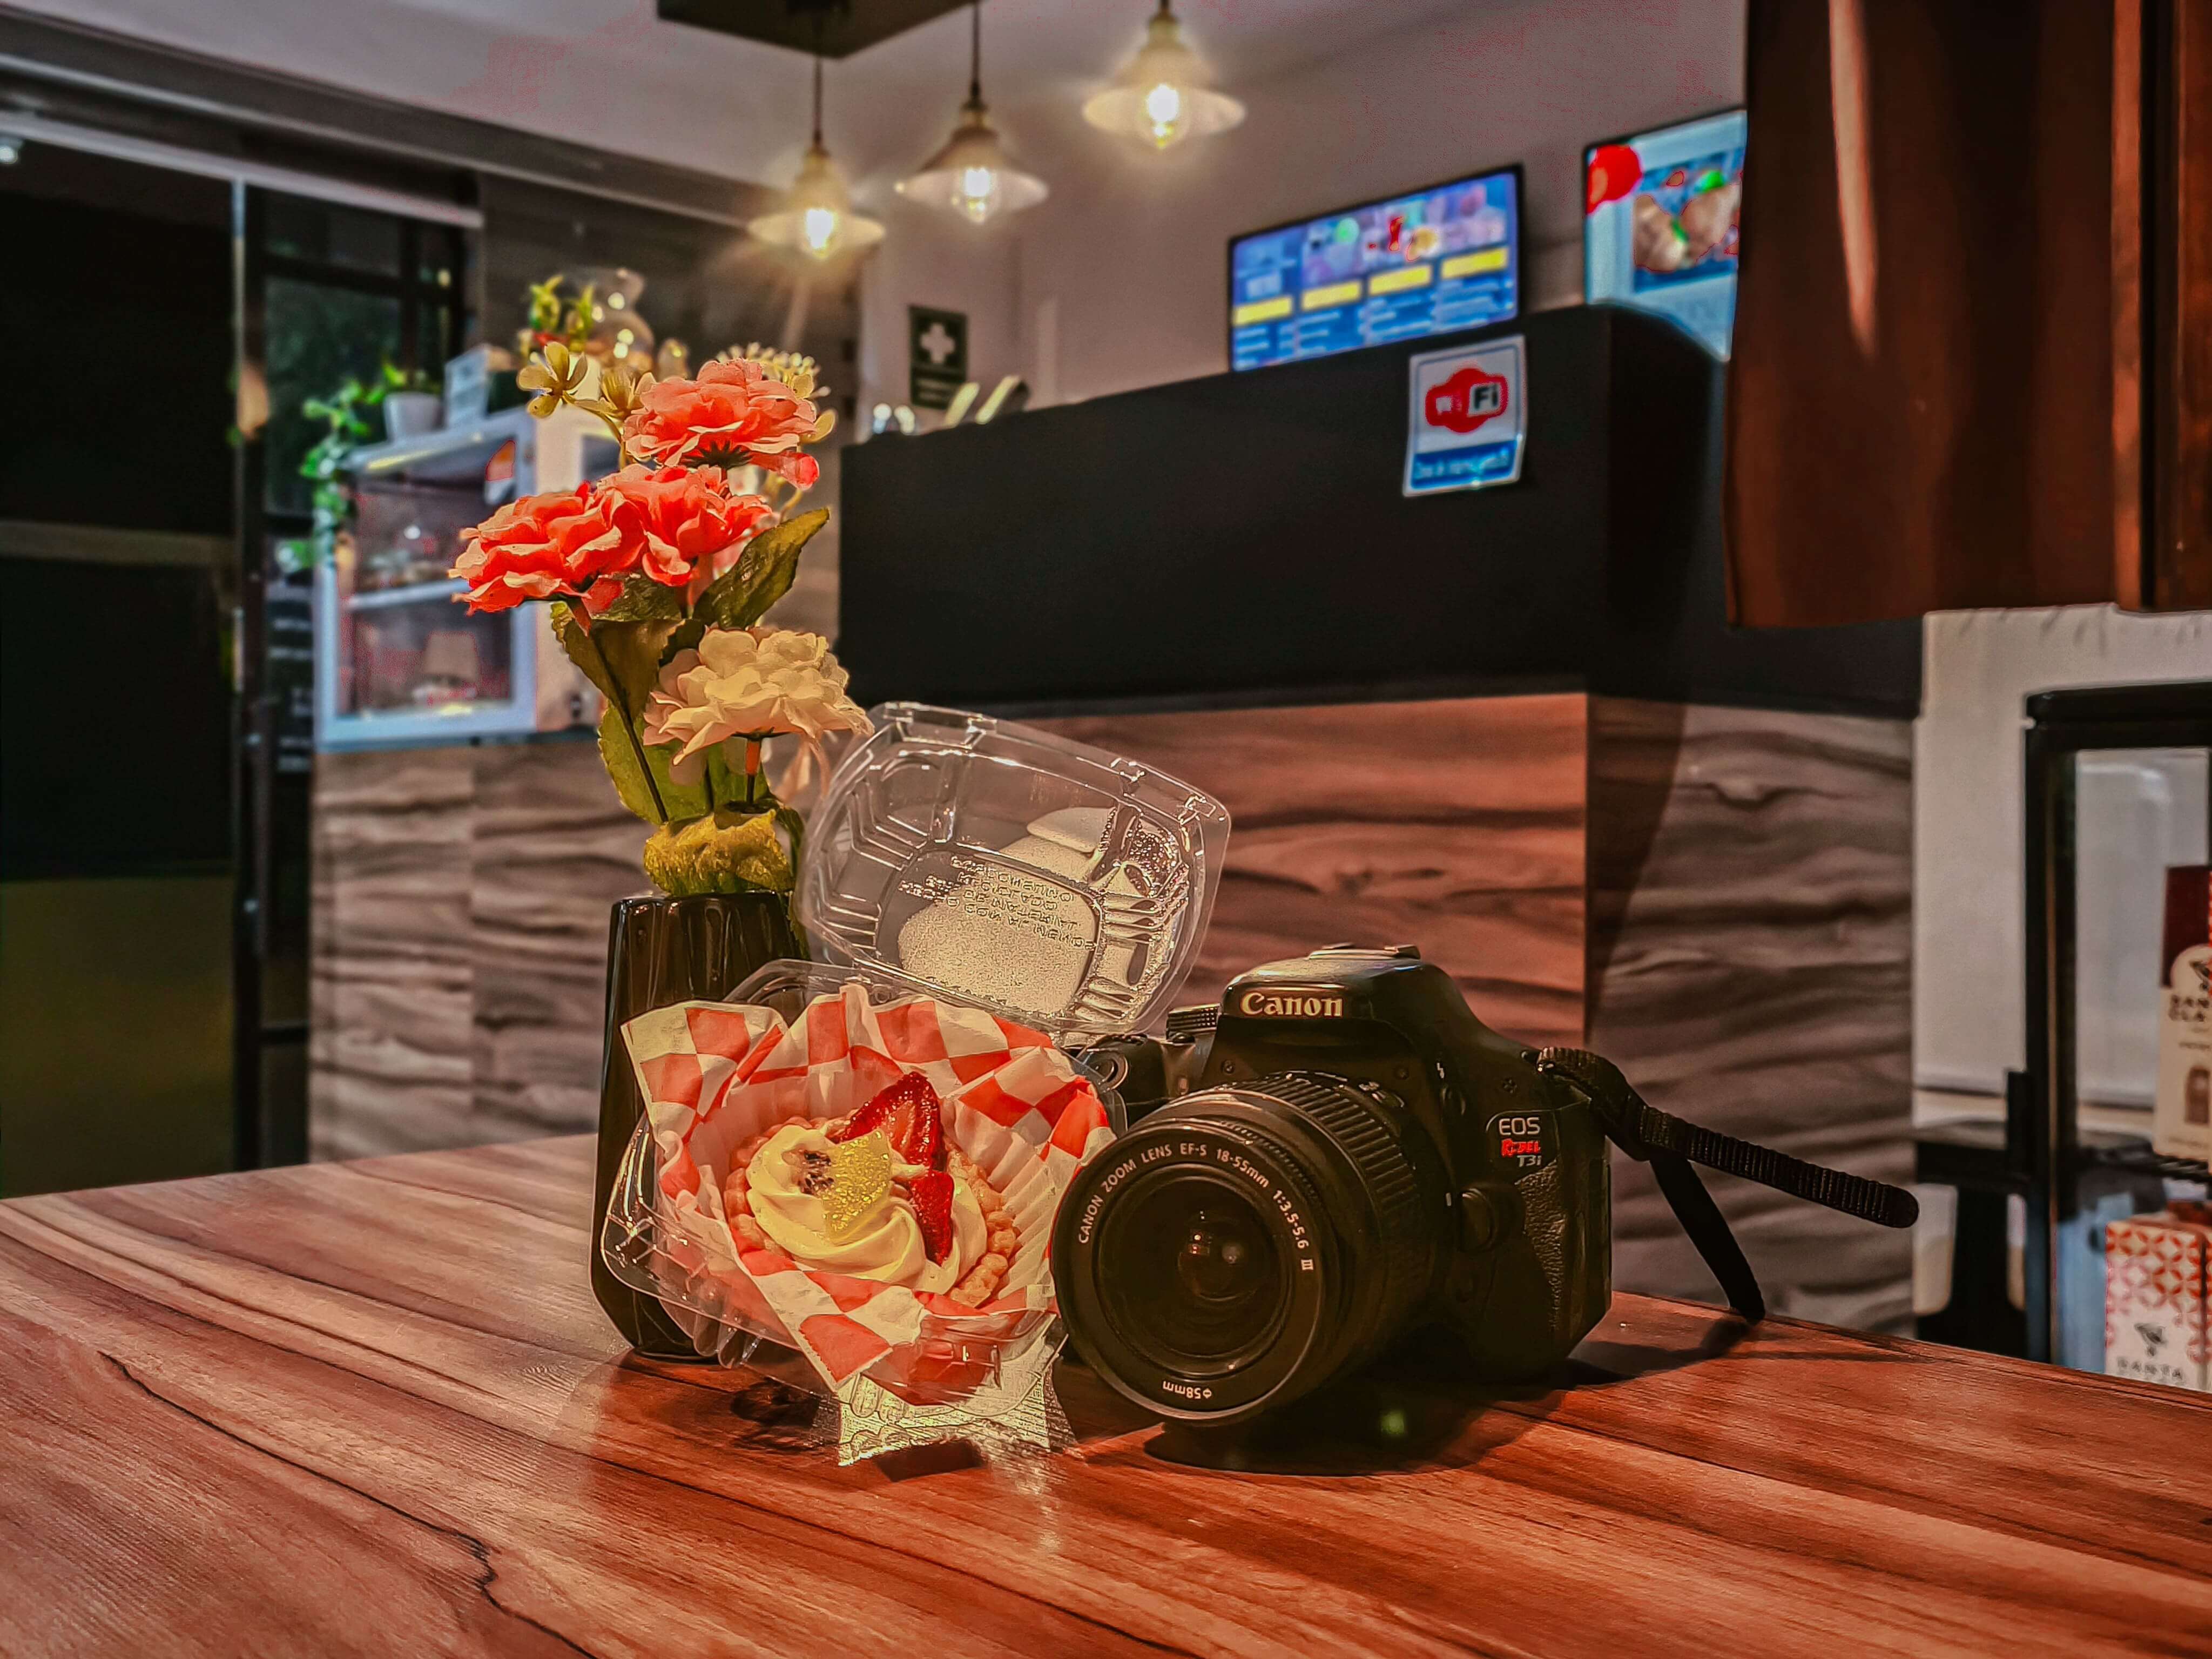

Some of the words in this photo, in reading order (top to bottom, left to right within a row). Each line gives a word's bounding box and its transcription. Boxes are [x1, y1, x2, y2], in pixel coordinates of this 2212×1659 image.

[1240, 992, 1343, 1017] Canon
[1499, 1117, 1541, 1136] EOS
[1516, 1155, 1542, 1168] T3i
[1078, 1195, 1103, 1244] CANON
[1100, 1159, 1137, 1192] ZOOM
[1141, 1144, 1172, 1163] LENS
[1179, 1143, 1207, 1156] EF-S
[1216, 1148, 1269, 1188] 18-55mm
